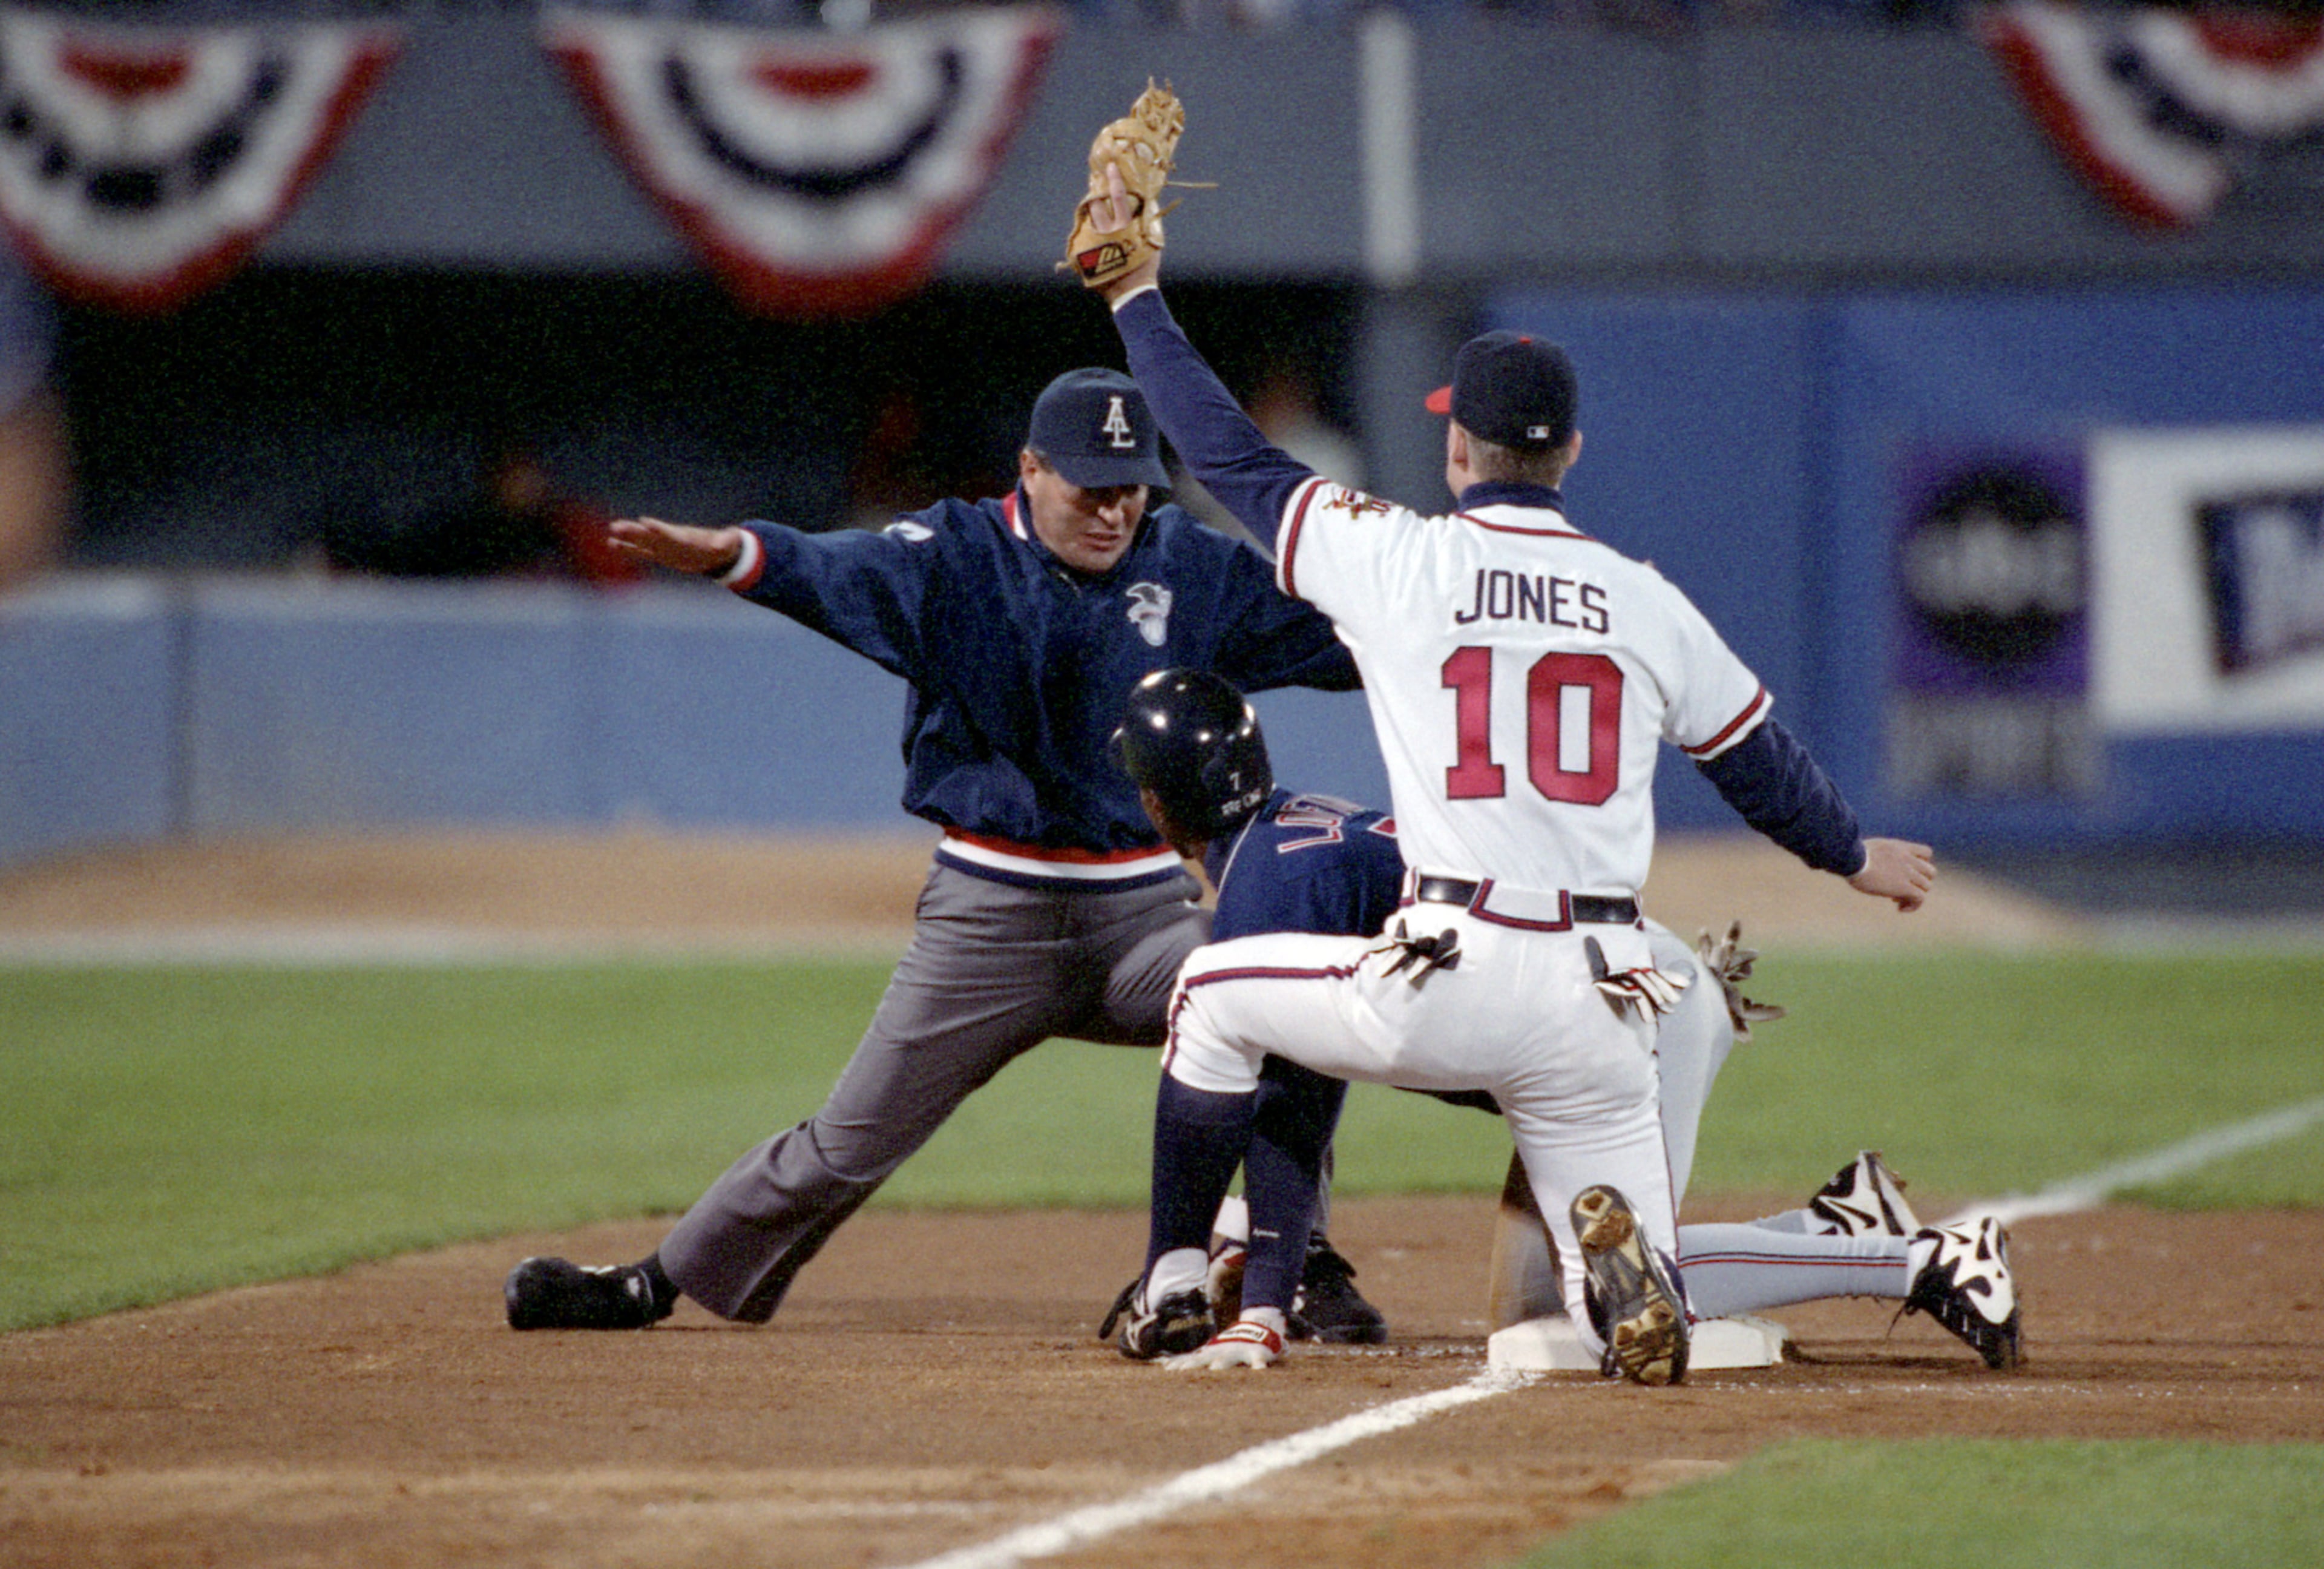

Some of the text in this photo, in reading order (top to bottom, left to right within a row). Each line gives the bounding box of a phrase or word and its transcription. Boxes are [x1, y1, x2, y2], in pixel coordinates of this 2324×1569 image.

[1102, 396, 1136, 448] AL
[1455, 568, 1609, 634] JONES
[1441, 646, 1624, 808] 10
